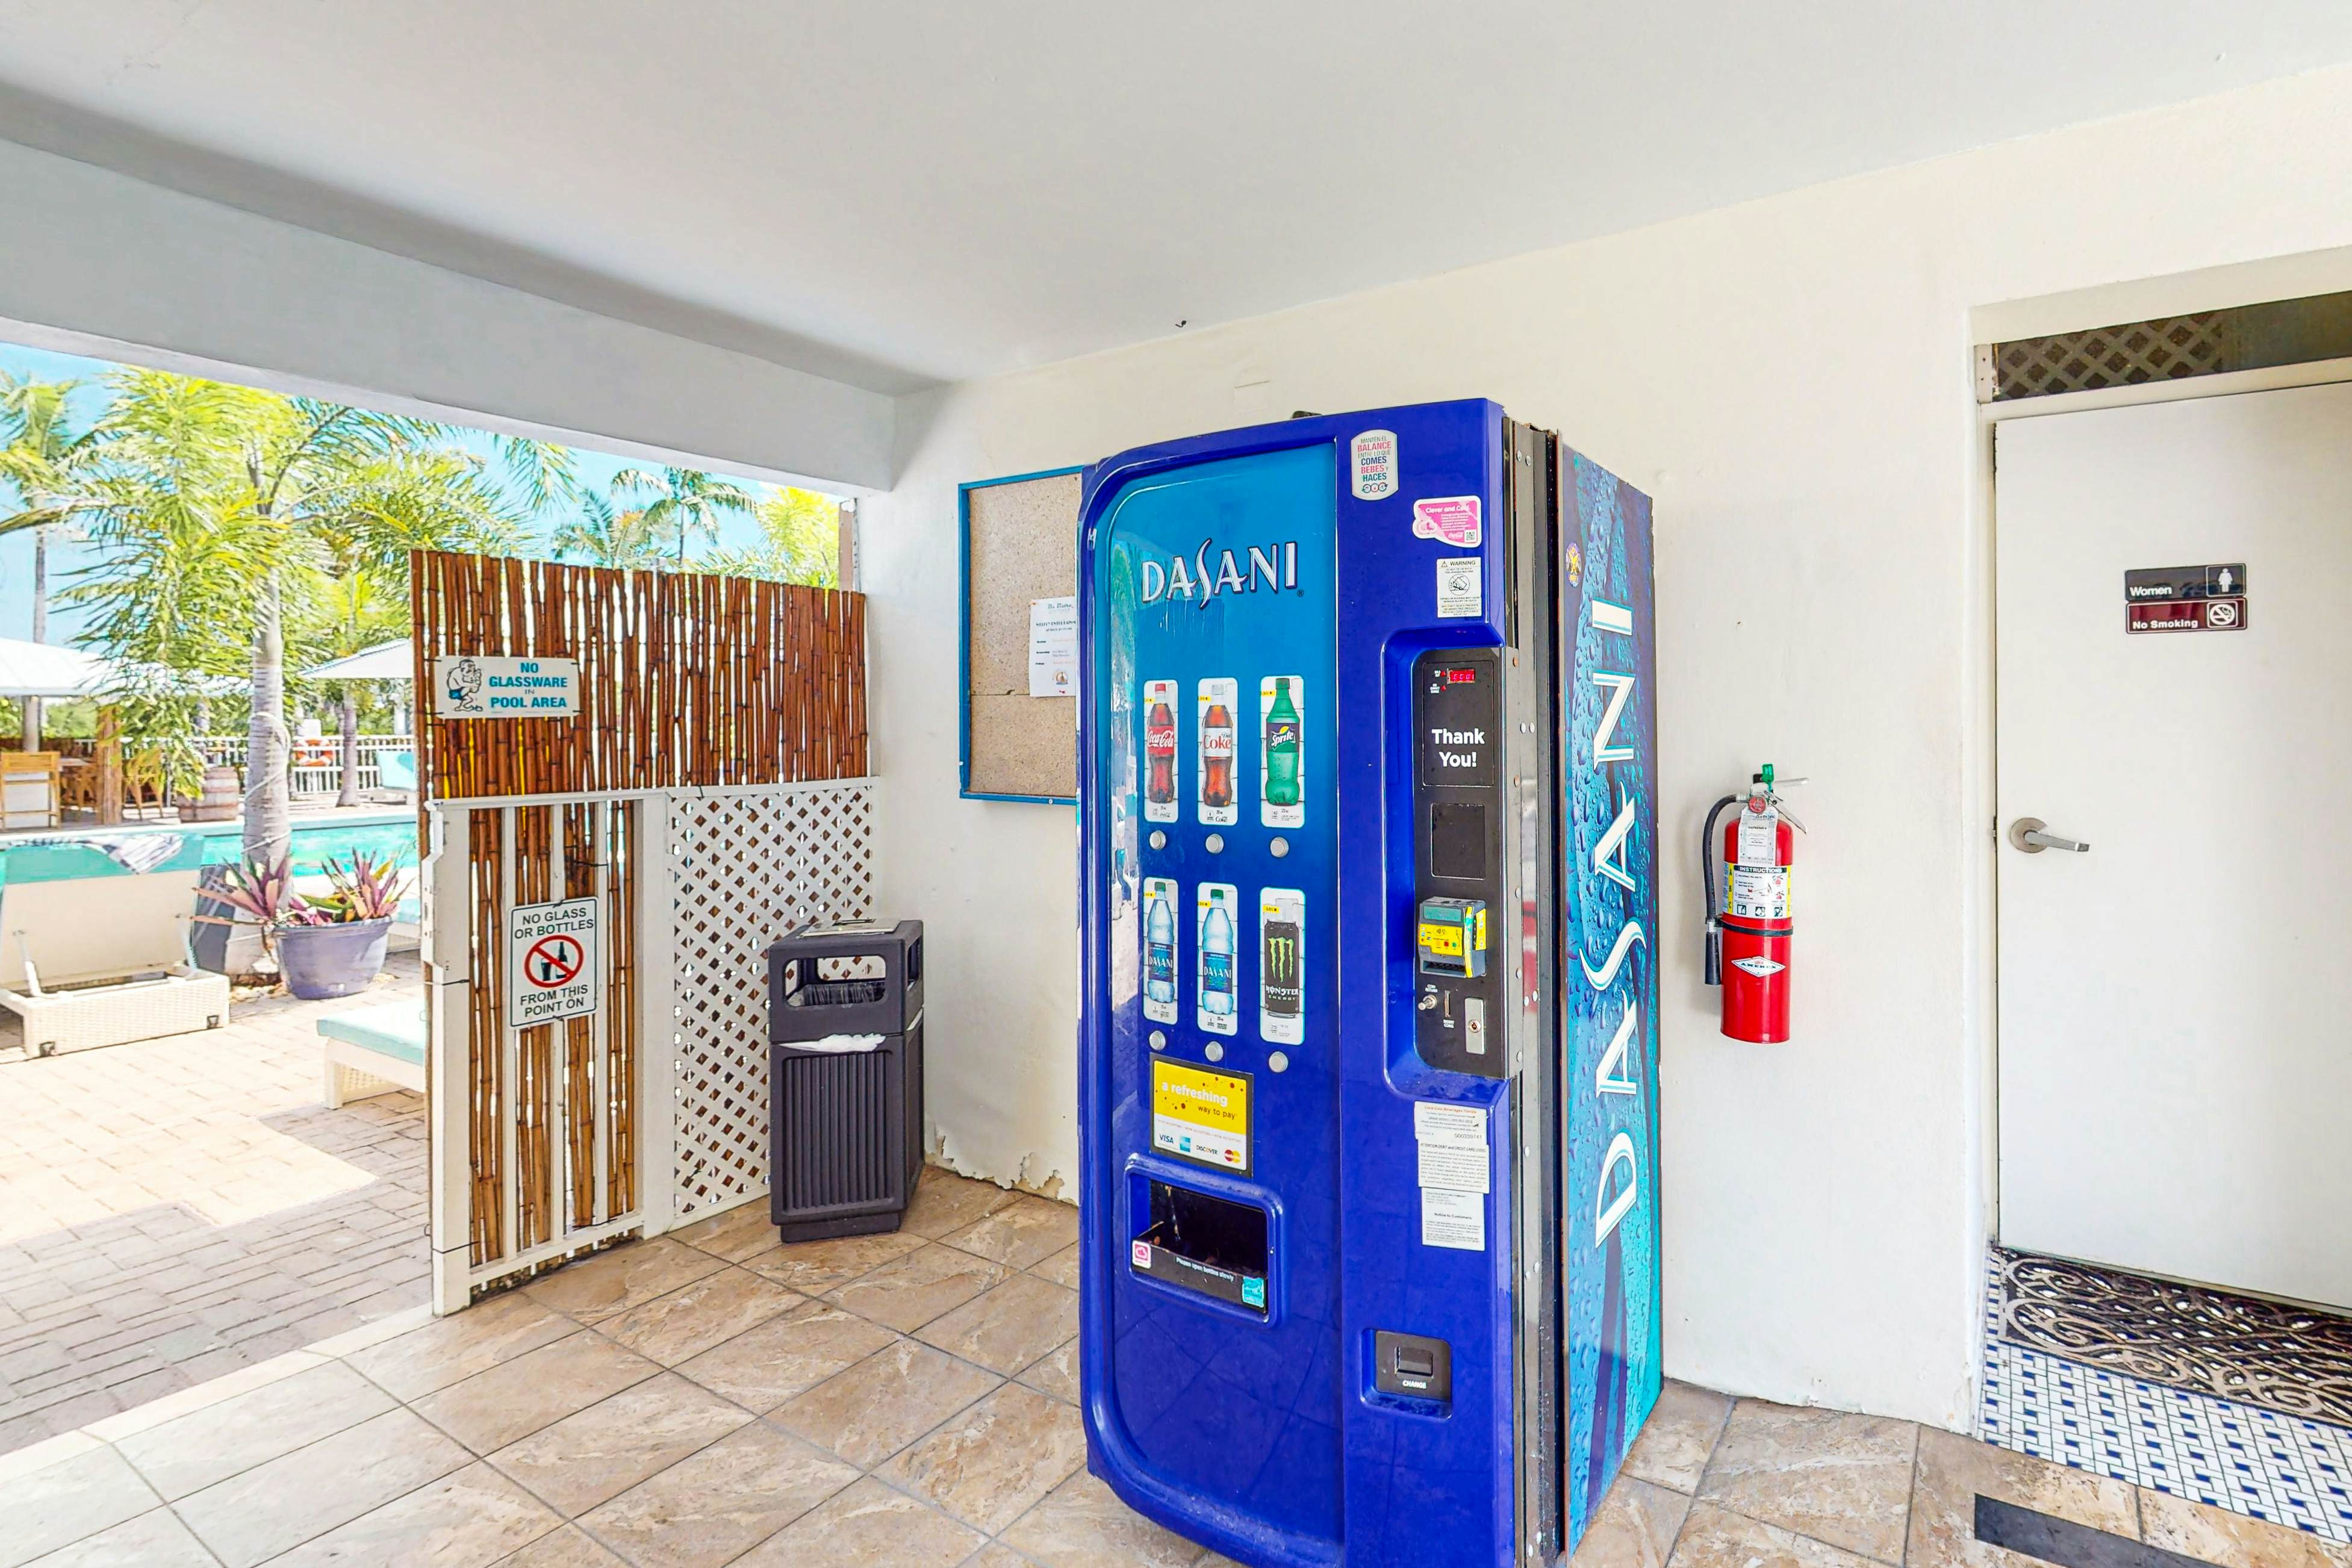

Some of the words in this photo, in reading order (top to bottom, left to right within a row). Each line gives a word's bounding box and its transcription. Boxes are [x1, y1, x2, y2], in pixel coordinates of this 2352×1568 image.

[1358, 441, 1392, 452] BALANCE
[1361, 456, 1387, 465] COMES
[1361, 465, 1384, 474] BEBES
[1363, 473, 1387, 482] HACES
[1142, 537, 1298, 610] DASANI
[2130, 586, 2172, 596] Women
[2132, 621, 2148, 629] No
[2150, 620, 2198, 629] Smoking
[520, 662, 538, 673] NO
[489, 677, 568, 688] GLASSWARE
[491, 697, 527, 708] POOL
[531, 697, 567, 708] AREA
[1204, 735, 1231, 749] Coke
[1271, 730, 1294, 747] Sprite
[1431, 728, 1485, 744] Thank
[1439, 751, 1477, 767] You!
[523, 914, 541, 925] NO
[544, 907, 586, 921] GLASS
[515, 928, 533, 939] OR
[537, 919, 594, 936] BOTTLES
[1579, 597, 1647, 1249] DASANI
[521, 990, 556, 1006] FROM
[561, 985, 588, 998] THIS
[525, 1001, 562, 1017] POINT
[567, 997, 584, 1009] ON
[1162, 1082, 1168, 1091] a
[1171, 1084, 1228, 1107] refreshing
[1198, 1106, 1211, 1115] way
[1223, 1111, 1236, 1120] pay
[1160, 1134, 1174, 1145] VISA
[1196, 1145, 1218, 1156] DISCOVER
[1402, 1380, 1427, 1389] CHANGE
